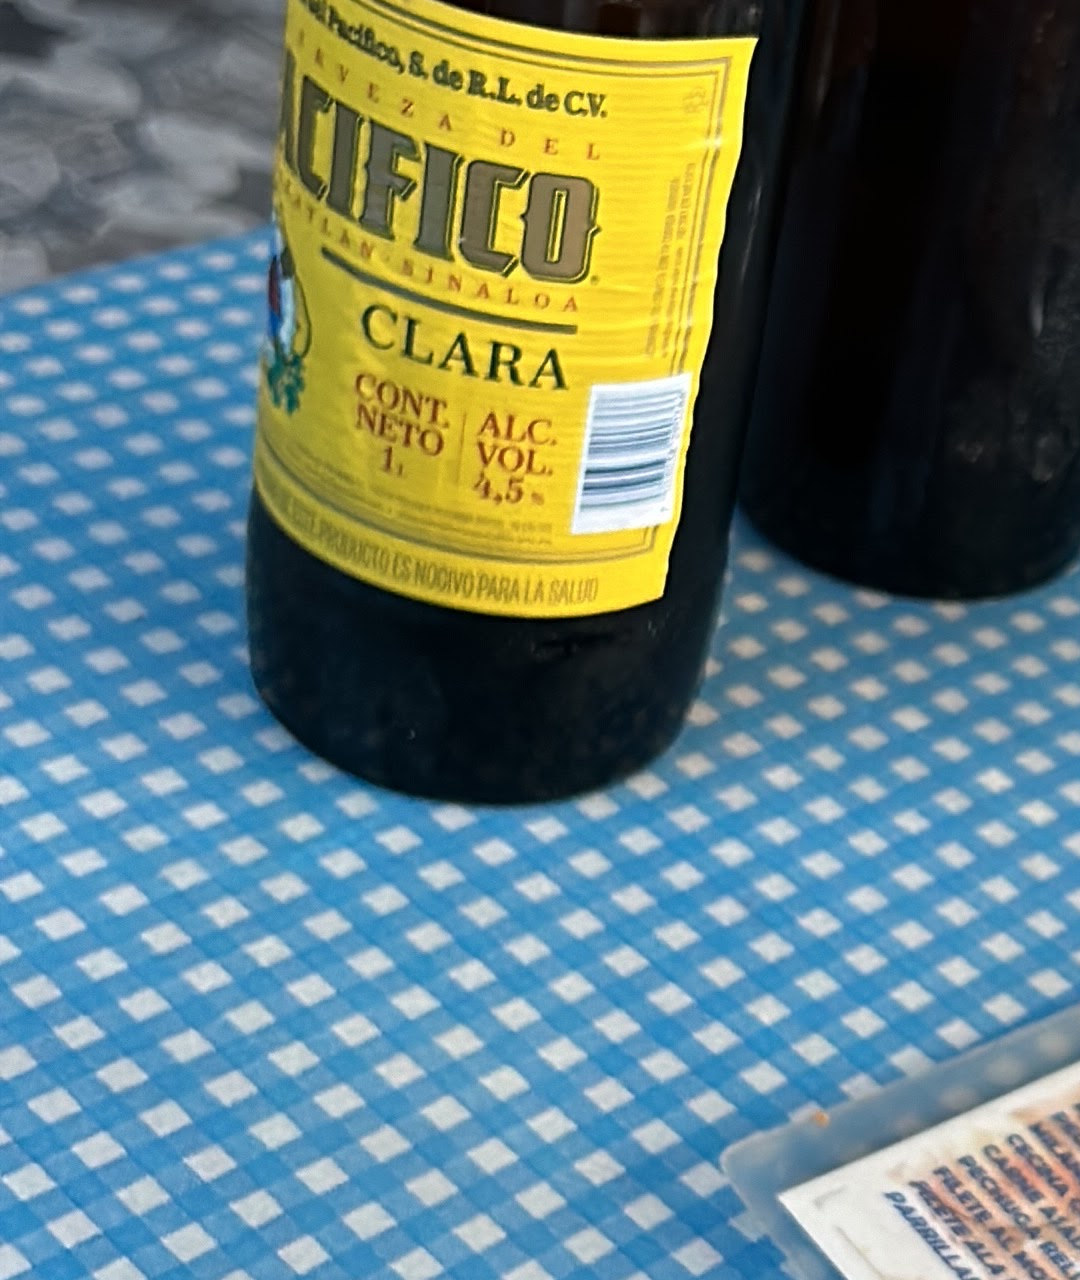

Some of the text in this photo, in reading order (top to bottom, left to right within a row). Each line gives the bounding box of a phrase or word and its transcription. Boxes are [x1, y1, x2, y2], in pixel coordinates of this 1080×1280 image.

[433, 60, 463, 90] de
[467, 70, 522, 106] R.L.
[527, 84, 559, 112] de
[564, 91, 607, 119] C.V.
[500, 130, 601, 161] DEL
[402, 259, 578, 312] SINALOA
[361, 304, 568, 391] CLARA
[355, 373, 449, 429] CONT.
[355, 403, 444, 456] NETO
[478, 411, 557, 446] ALC.
[477, 441, 553, 476] VOL.
[414, 559, 475, 598] NOCIVO
[477, 573, 519, 604] PARA
[524, 576, 545, 604] LA
[549, 577, 599, 606] SALUD
[981, 1144, 1044, 1203] CARNE
[1005, 1134, 1069, 1198] CECINA
[907, 1179, 971, 1237] FILETE
[932, 1167, 993, 1224] FILETE
[987, 1227, 1014, 1251] AL
[956, 1154, 1041, 1240] PECHUGA
